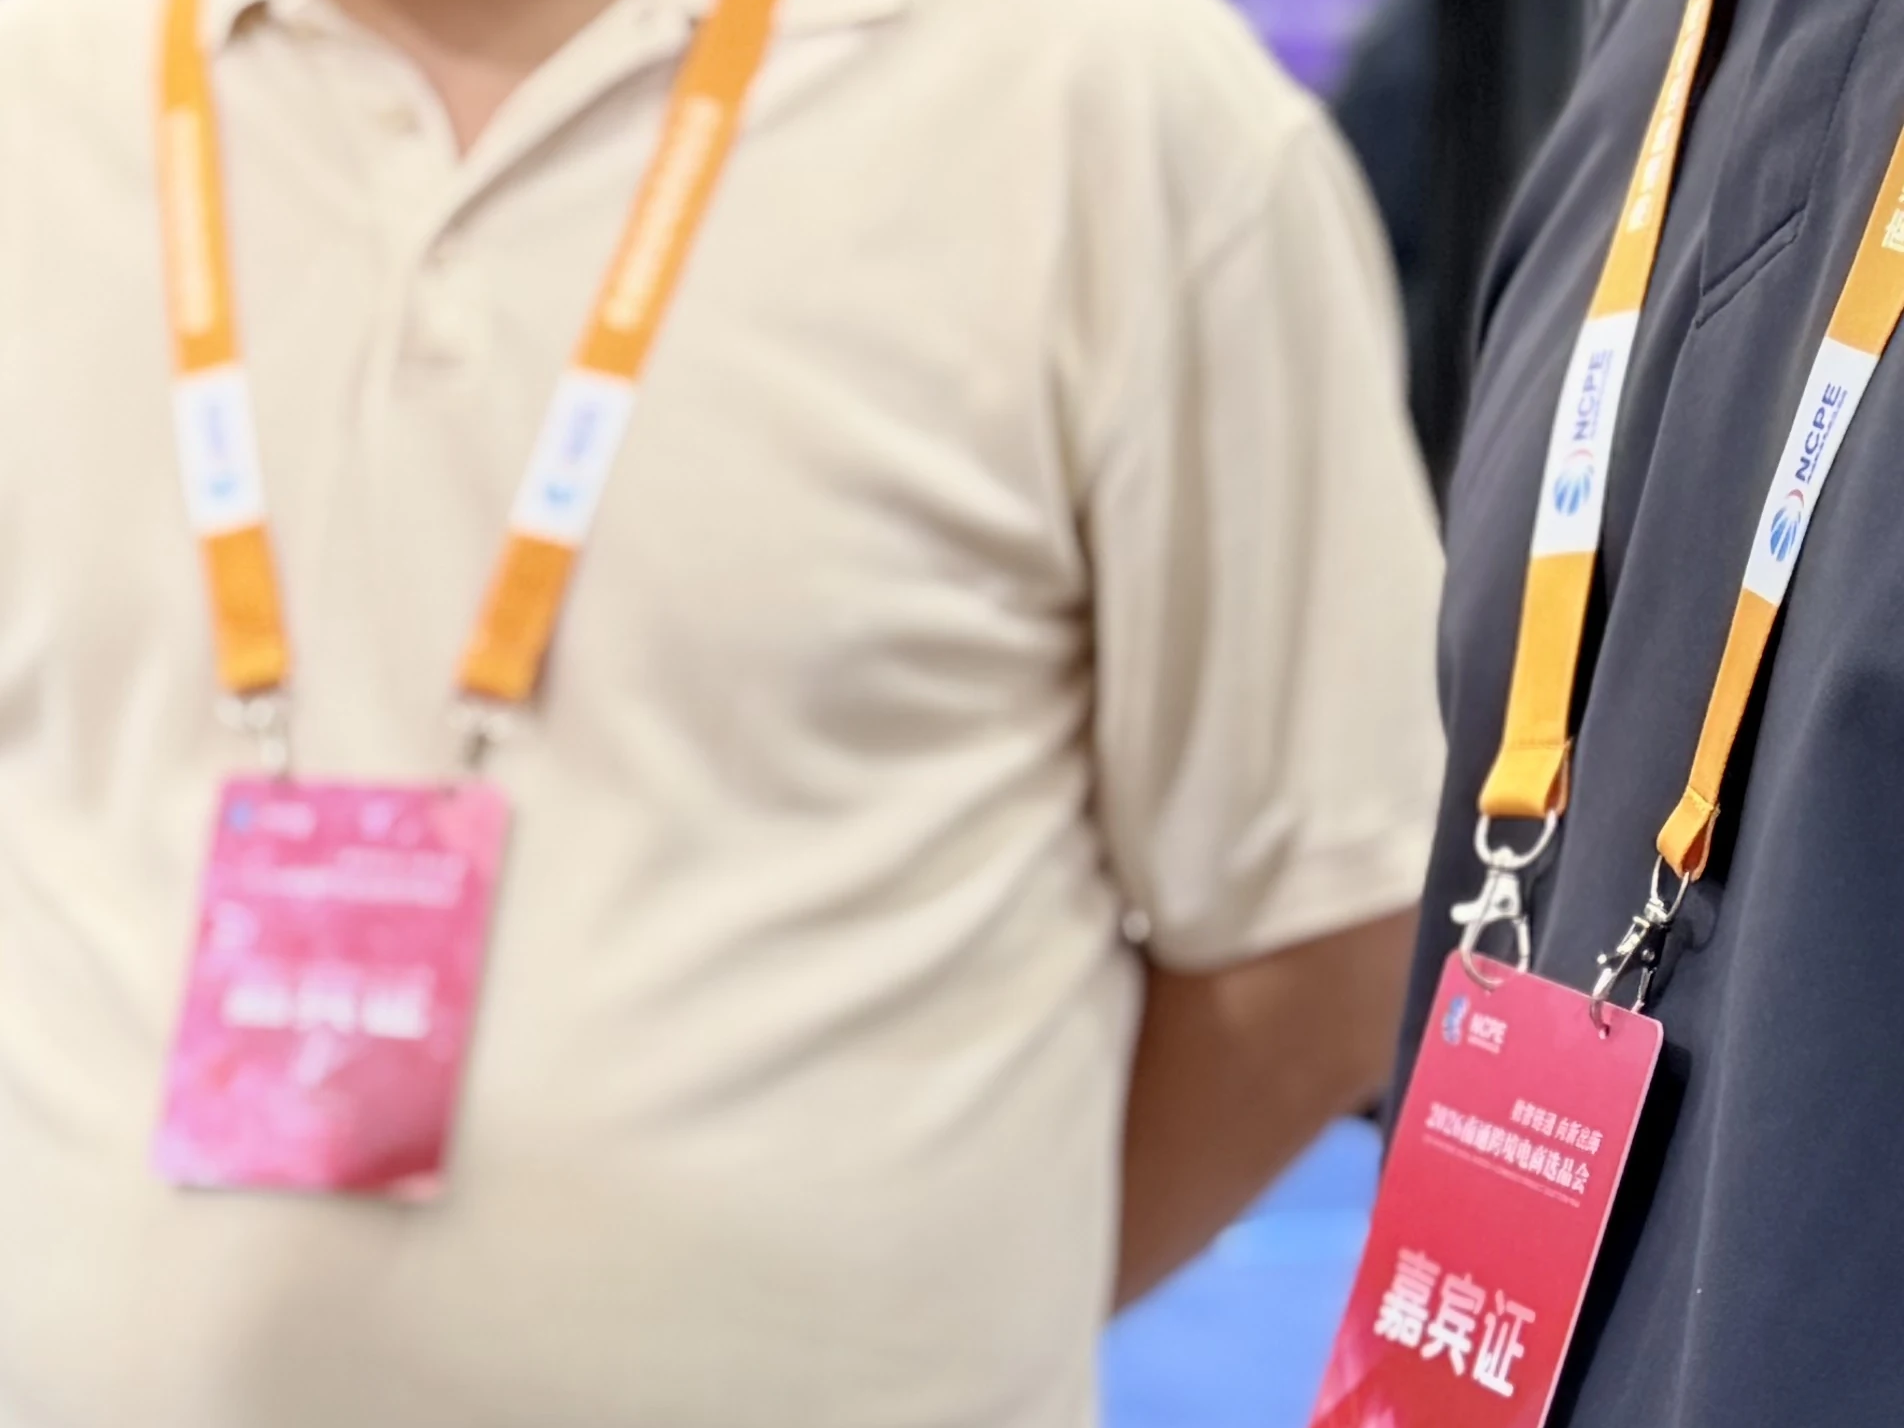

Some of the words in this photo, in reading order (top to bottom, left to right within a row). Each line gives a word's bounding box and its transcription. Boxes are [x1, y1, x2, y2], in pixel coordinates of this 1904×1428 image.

[1573, 350, 1606, 441] NCPE
[1795, 383, 1841, 482] NCPE
[1373, 1248, 1536, 1398] 嘉宾证
